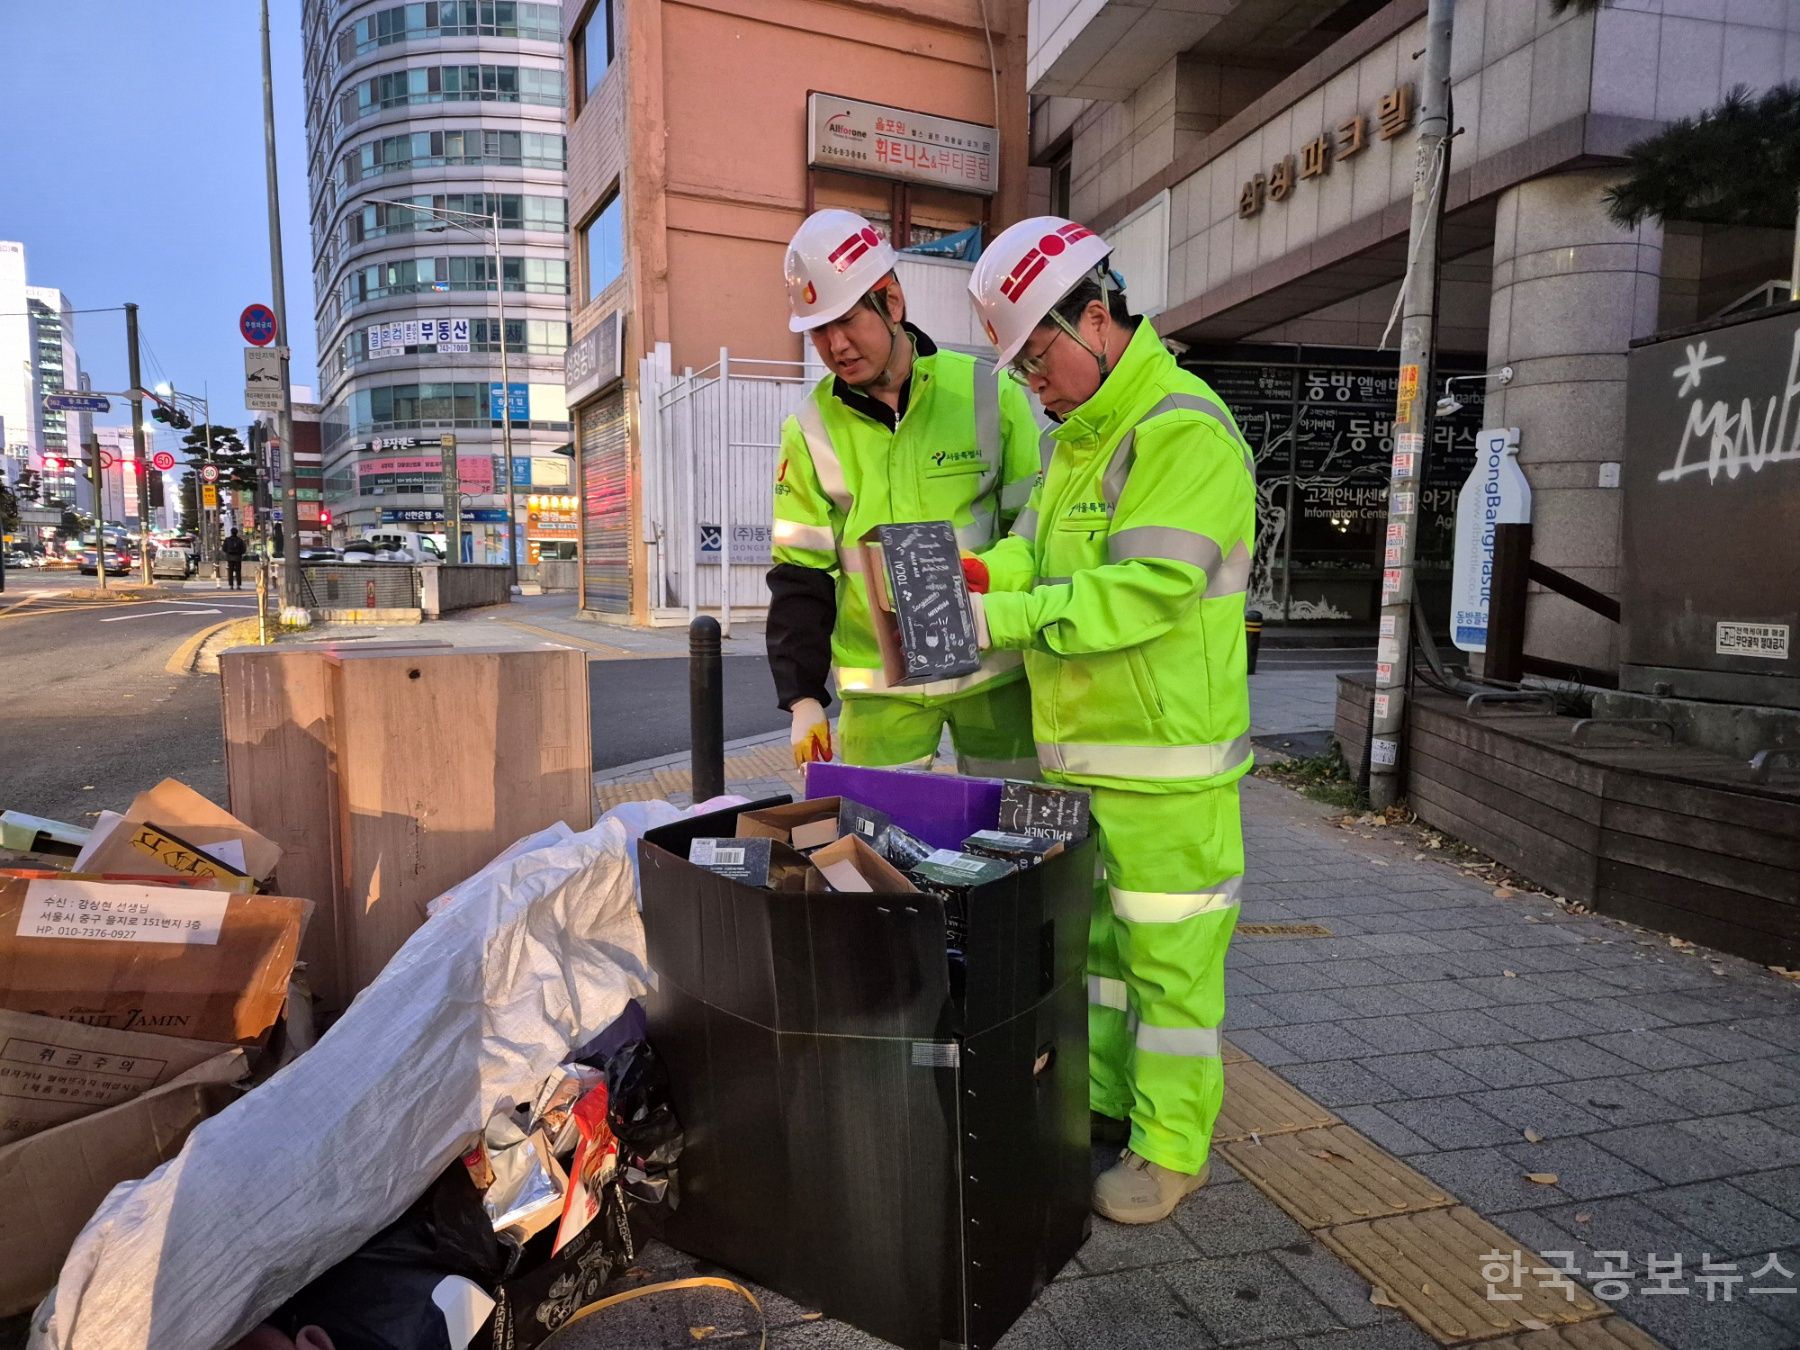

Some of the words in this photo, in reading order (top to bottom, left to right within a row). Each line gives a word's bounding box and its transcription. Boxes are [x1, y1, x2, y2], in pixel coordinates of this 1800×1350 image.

[829, 123, 867, 139] Allforone
[875, 116, 906, 135] 올포원
[245, 321, 272, 329] 주정차금지
[421, 321, 468, 343] 부동산
[248, 351, 275, 360] 견인지역
[382, 436, 416, 450] 포장랜드
[157, 455, 170, 466] 50
[946, 449, 982, 461] 서울특별시
[404, 511, 432, 520] 신한은행
[1303, 507, 1358, 519] Information
[1360, 507, 1389, 519] Cente
[894, 560, 908, 587] TOCAI
[1735, 635, 1759, 648] 무단굴착
[1760, 637, 1785, 650] 절대금지
[1024, 825, 1073, 842] #PILSNER
[44, 897, 67, 908] 수신
[116, 901, 149, 914] 선생님
[40, 911, 75, 923] 서울시
[79, 913, 101, 925] 중구
[105, 915, 138, 926] 을지로
[142, 917, 181, 929] 151번지
[185, 919, 202, 930] 3층
[57, 926, 137, 939] 010-7376-0927
